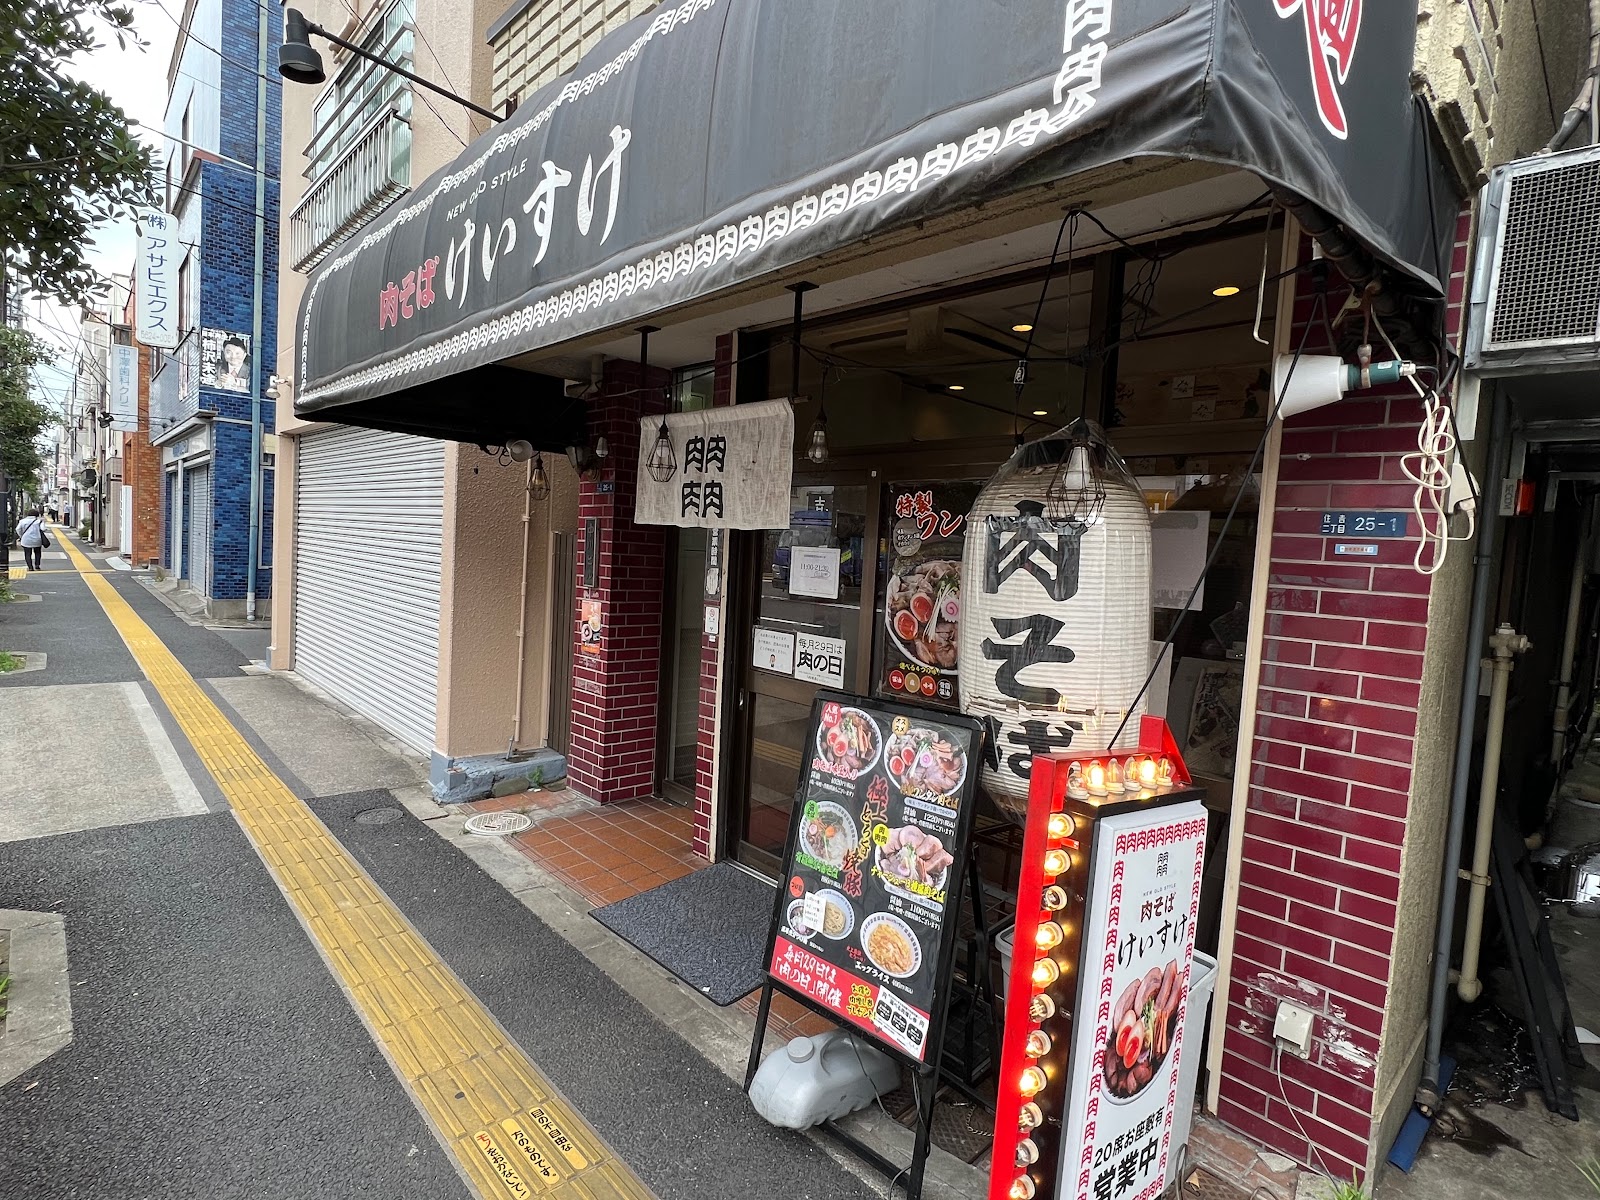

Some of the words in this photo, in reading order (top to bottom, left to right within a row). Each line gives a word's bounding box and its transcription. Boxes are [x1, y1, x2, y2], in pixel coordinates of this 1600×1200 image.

[446, 203, 467, 221] NEW
[491, 158, 528, 189] STYLE
[445, 125, 632, 309] けいすけ
[146, 236, 168, 332] アサヒエクス
[379, 255, 440, 330] 肉そば
[896, 491, 933, 518] 特製
[917, 510, 970, 540] ワン
[1322, 524, 1346, 534] 二丁目
[1355, 517, 1397, 531] 25-1
[799, 638, 843, 655] 毎月29日は
[980, 500, 1088, 780] 肉そば
[797, 650, 843, 677] 肉の日
[823, 712, 837, 724] No.1
[825, 704, 838, 714] 人気
[875, 834, 888, 844] 肉肉
[879, 827, 886, 835] 肉
[1140, 892, 1177, 922] 肉そば
[1118, 914, 1188, 969] けいすけ
[783, 942, 837, 986] 毎月29日は
[854, 960, 889, 984] エッグライス
[773, 955, 843, 1010] 「肉の日」開催
[1093, 1106, 1165, 1169] 20席お座敷有
[1093, 1136, 1159, 1200] 営業中
